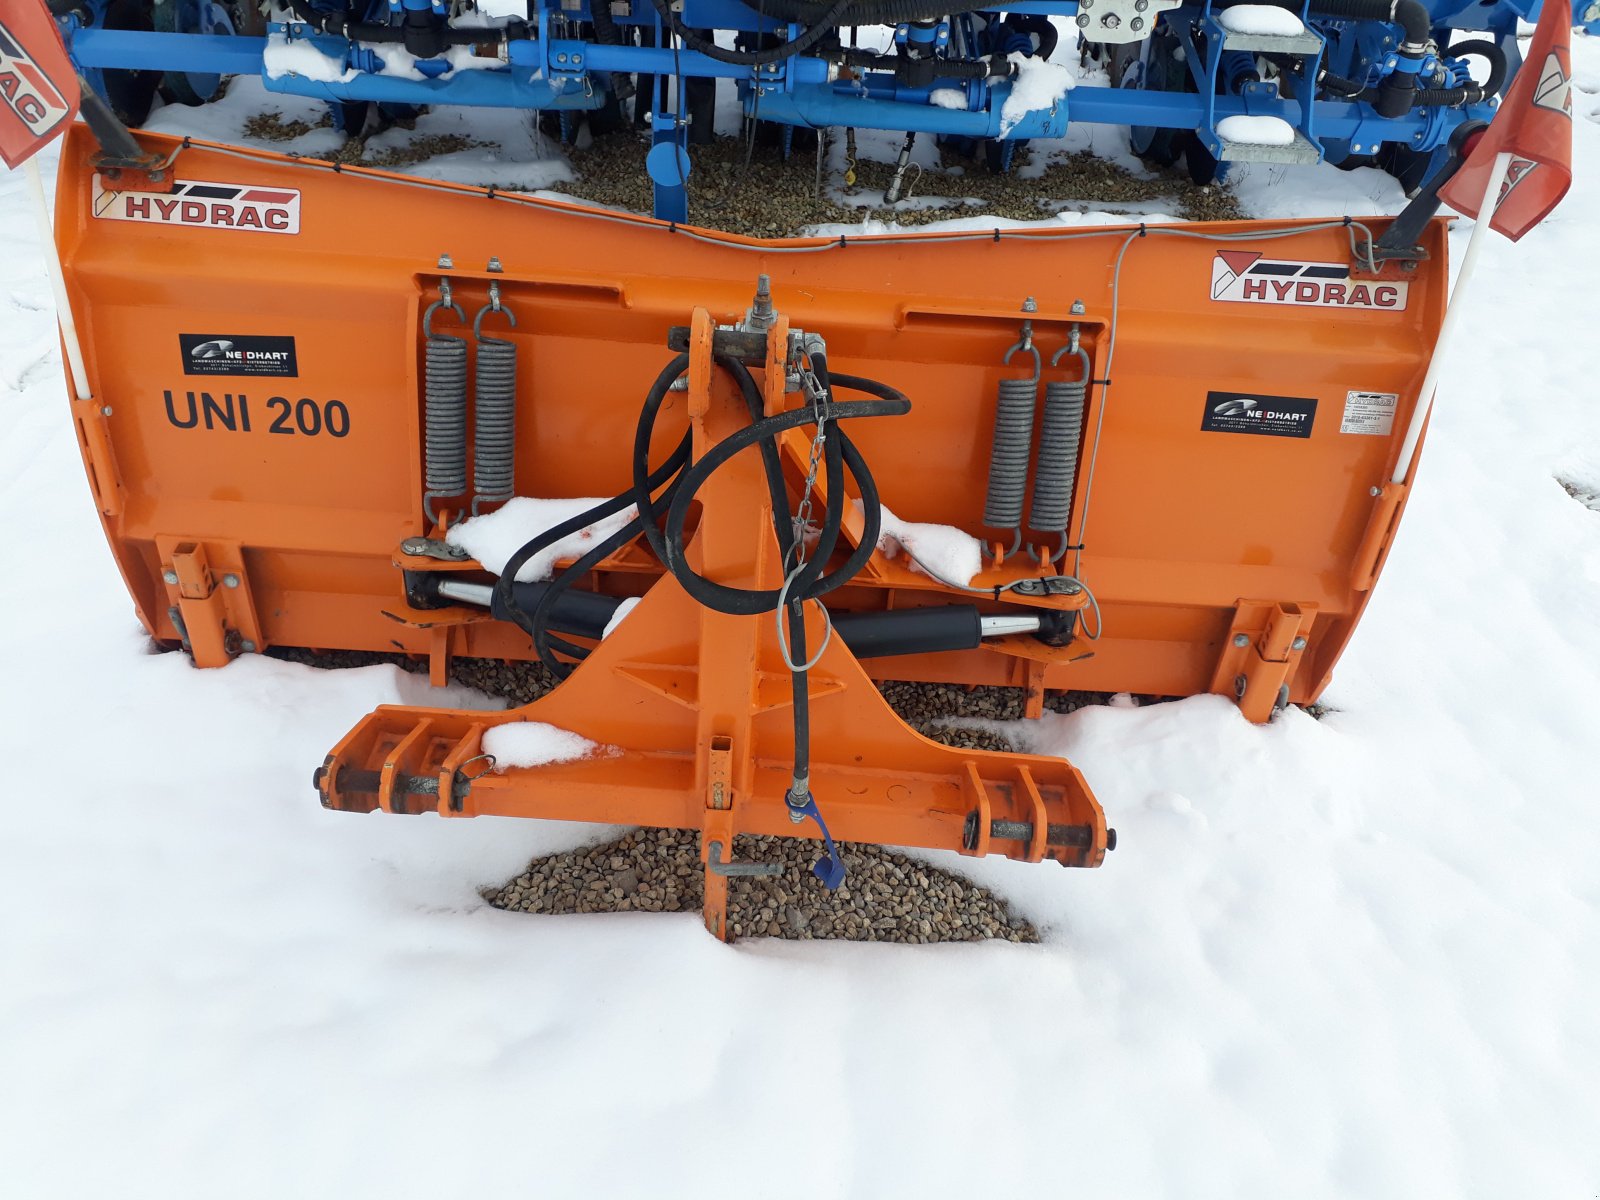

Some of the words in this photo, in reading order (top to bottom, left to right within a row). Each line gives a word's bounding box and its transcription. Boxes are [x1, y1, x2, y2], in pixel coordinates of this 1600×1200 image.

[0, 55, 46, 123] AC
[125, 197, 290, 230] HYDRAC
[1243, 279, 1397, 307] HYDRAC
[225, 351, 289, 360] NEIDHART
[163, 390, 251, 432] UNI
[266, 396, 350, 438] 200
[1246, 409, 1308, 421] NEIDHART
